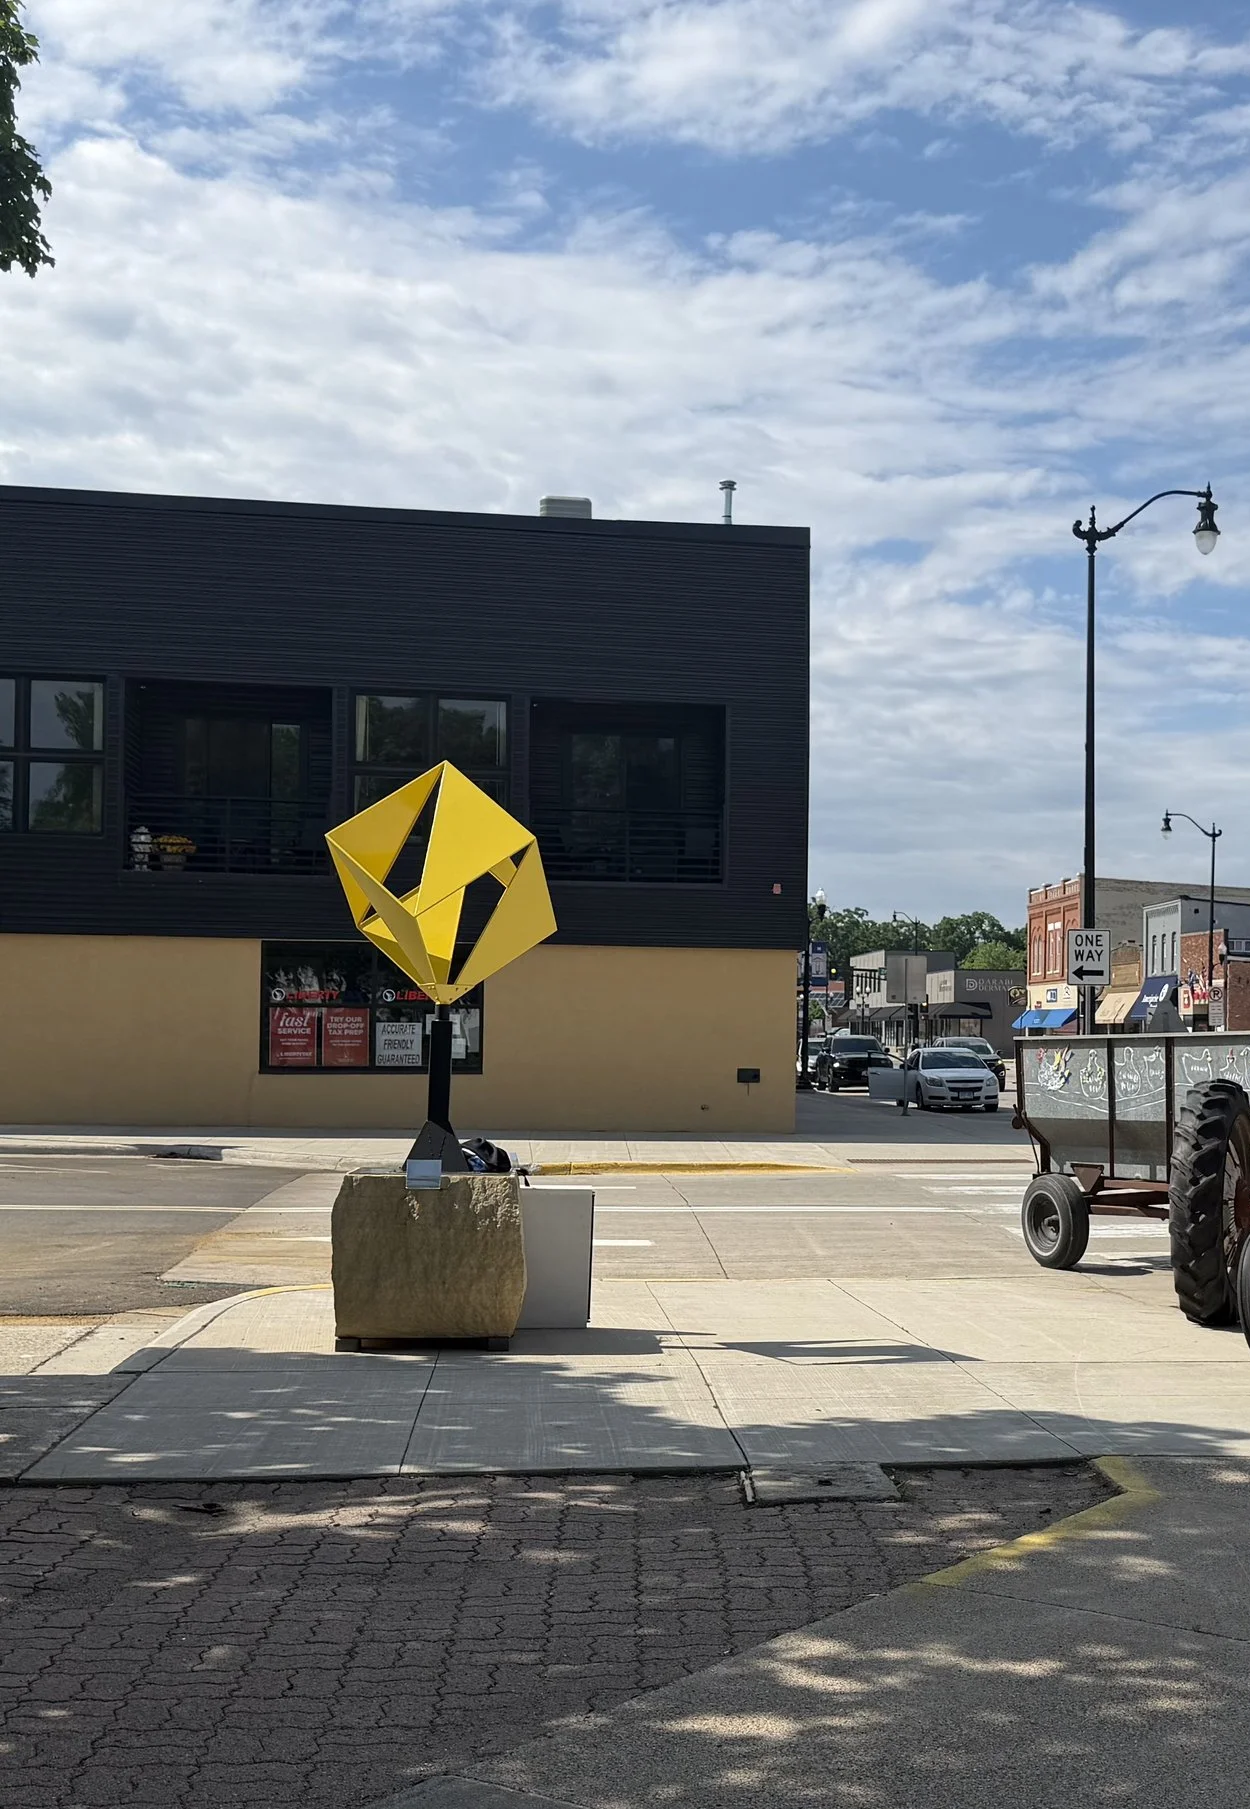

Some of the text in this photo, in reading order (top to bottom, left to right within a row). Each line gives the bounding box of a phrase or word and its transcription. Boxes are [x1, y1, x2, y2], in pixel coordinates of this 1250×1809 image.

[1075, 934, 1103, 947] ONE
[1074, 949, 1104, 962] WAY
[286, 991, 339, 1001] LIBERTY
[396, 991, 428, 1001] LIBE
[280, 1012, 310, 1027] fast
[382, 1024, 417, 1035] ACCURATE
[384, 1039, 415, 1050] FRIENDLY
[377, 1054, 420, 1065] GUARANTEED
